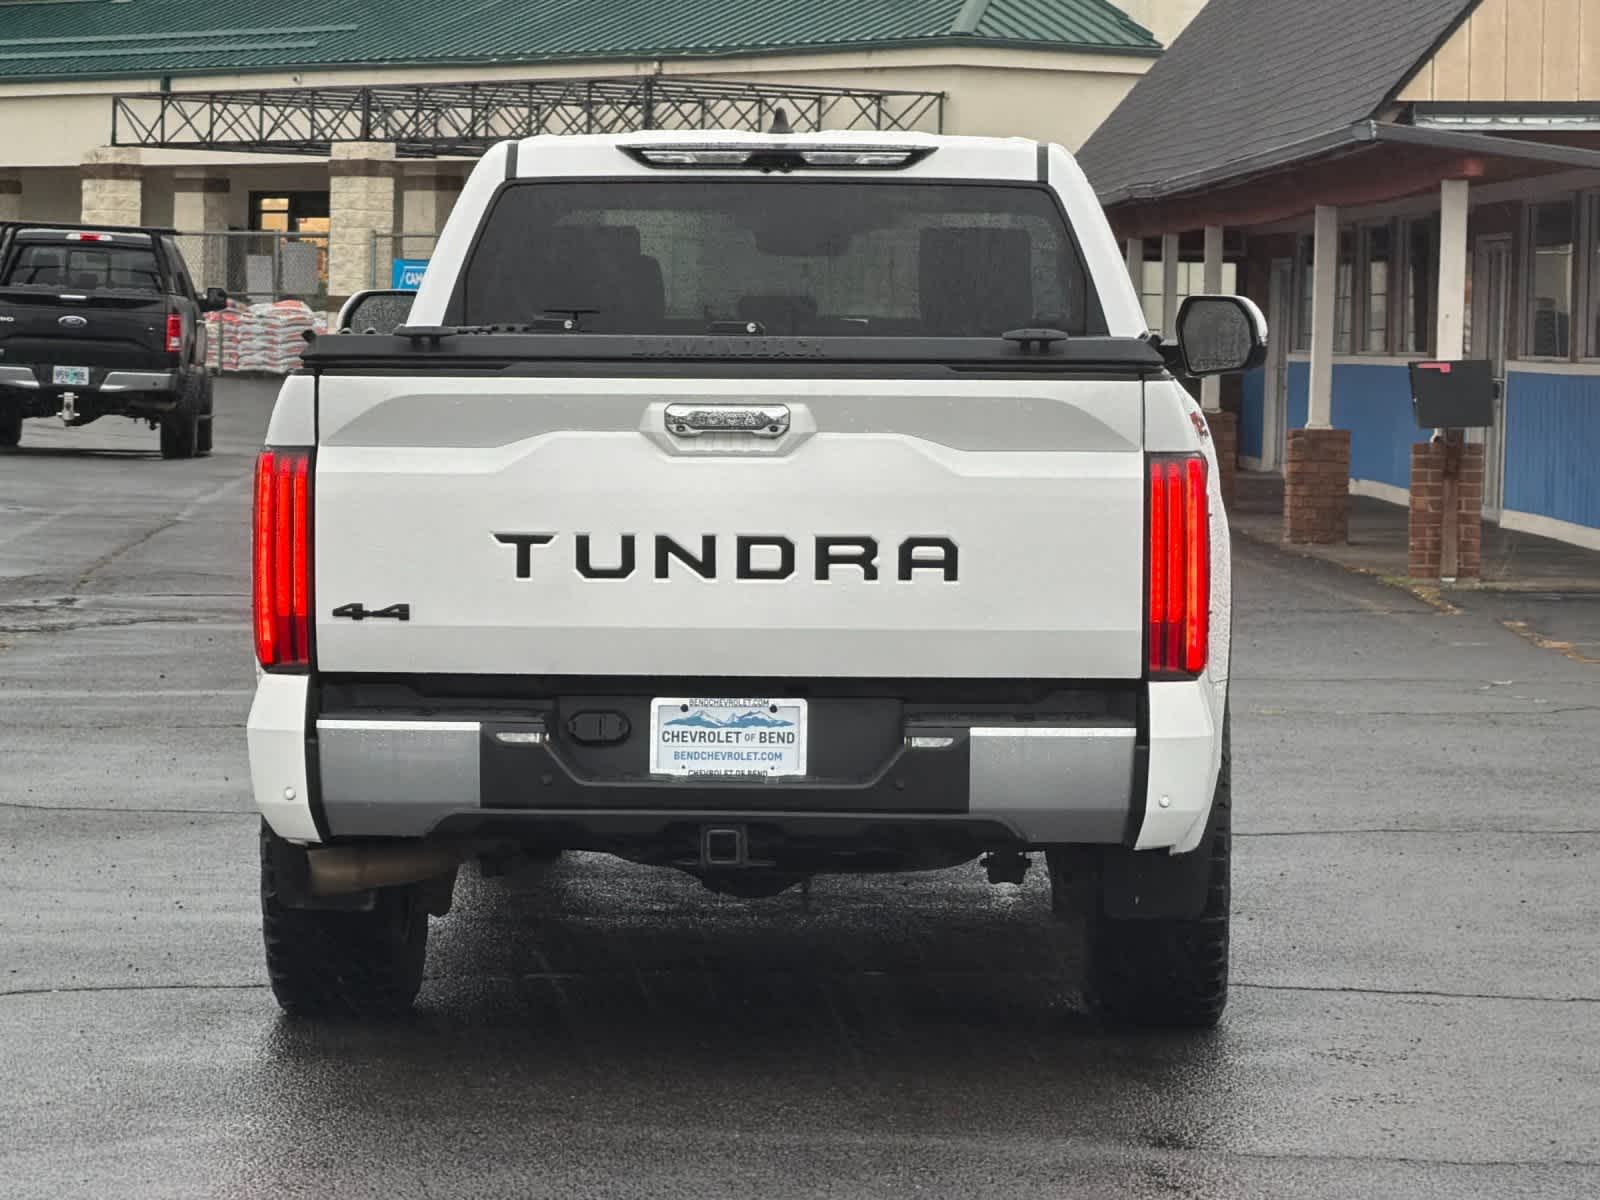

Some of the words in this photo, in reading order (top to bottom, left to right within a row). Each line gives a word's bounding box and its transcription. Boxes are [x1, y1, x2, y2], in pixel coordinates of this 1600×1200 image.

[493, 534, 959, 582] TUNDRA
[688, 698, 769, 708] BENDCHEVROLET.COM
[662, 730, 742, 744] CHEVROLET
[744, 733, 756, 742] OF
[759, 731, 795, 744] BEND
[673, 751, 783, 761] BENDCHEVROLET.COM
